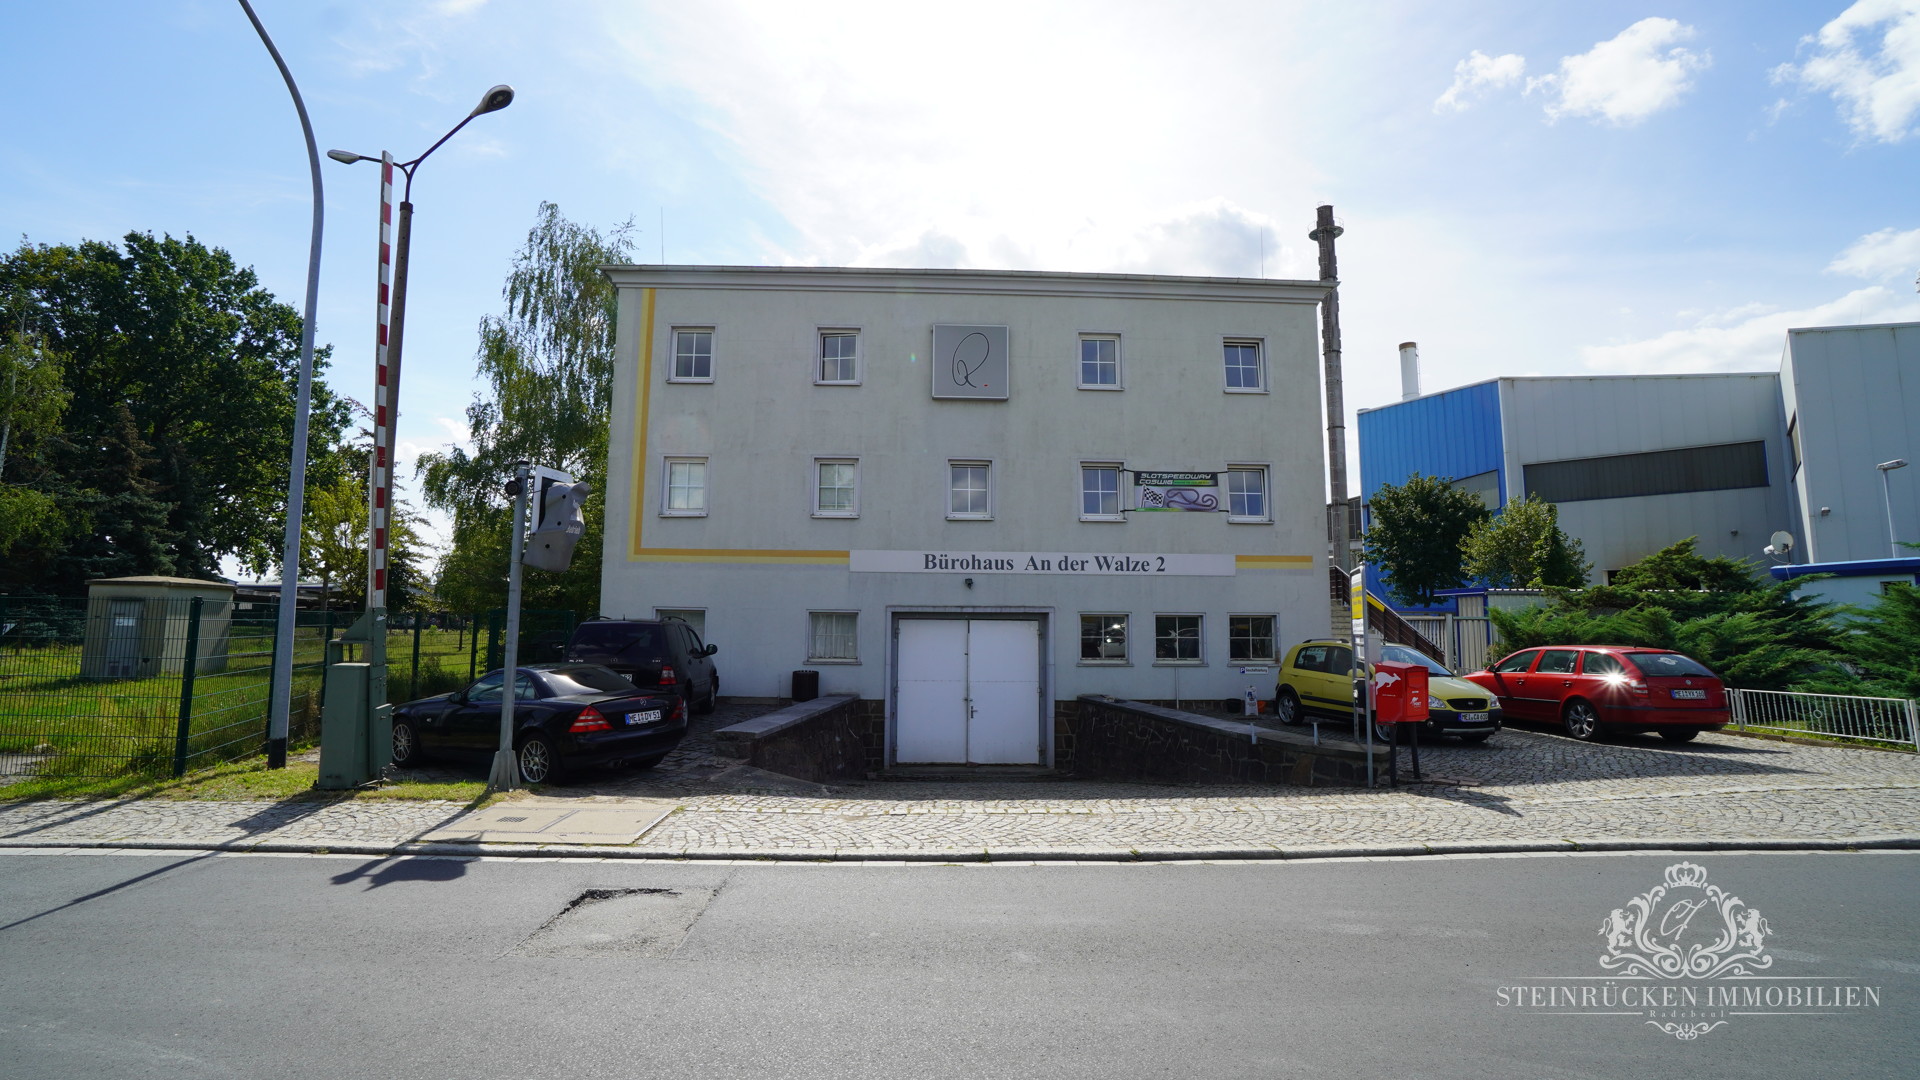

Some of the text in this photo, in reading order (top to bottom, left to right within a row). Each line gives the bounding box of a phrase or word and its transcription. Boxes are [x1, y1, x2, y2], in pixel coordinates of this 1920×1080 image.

[923, 553, 1166, 573] Bürohaus An der Walze 2
